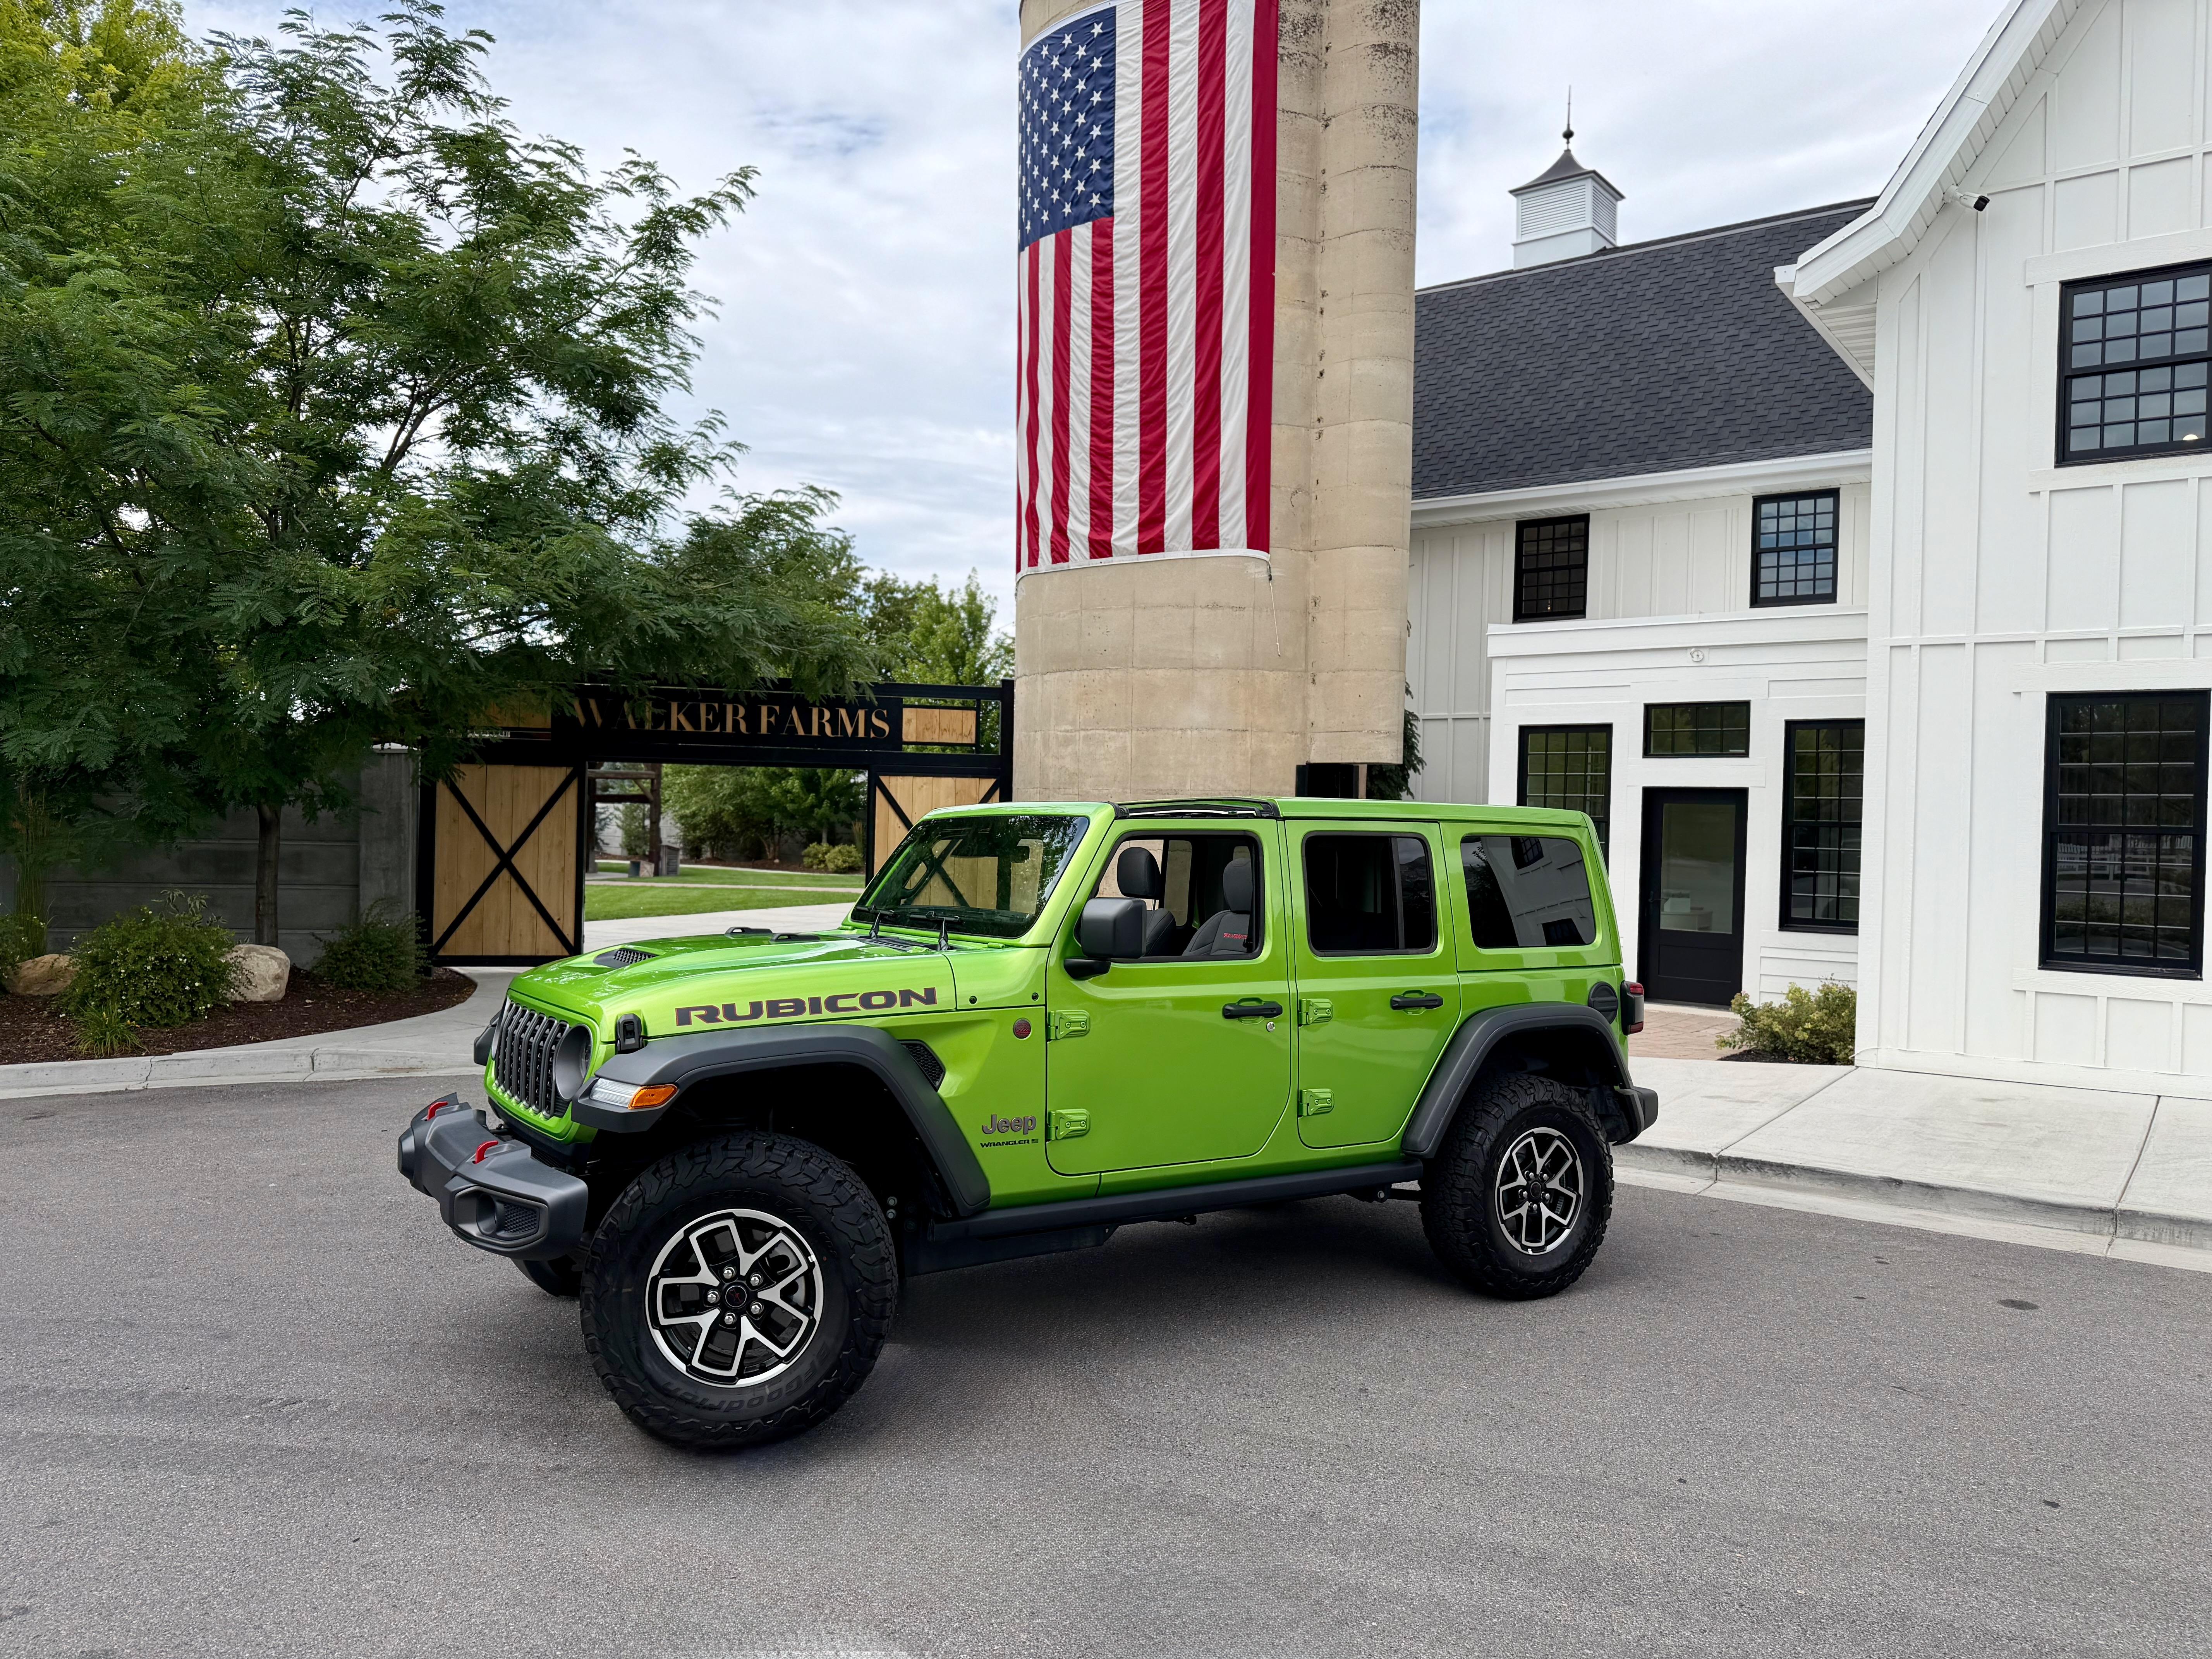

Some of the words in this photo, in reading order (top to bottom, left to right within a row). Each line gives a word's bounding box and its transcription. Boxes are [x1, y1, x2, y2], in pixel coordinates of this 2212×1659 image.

[571, 697, 750, 734] WALKER
[757, 704, 890, 739] FARMS
[675, 987, 937, 1026] RUBICON
[982, 1113, 1037, 1135] Jeep
[980, 1139, 1030, 1148] WRANGLER
